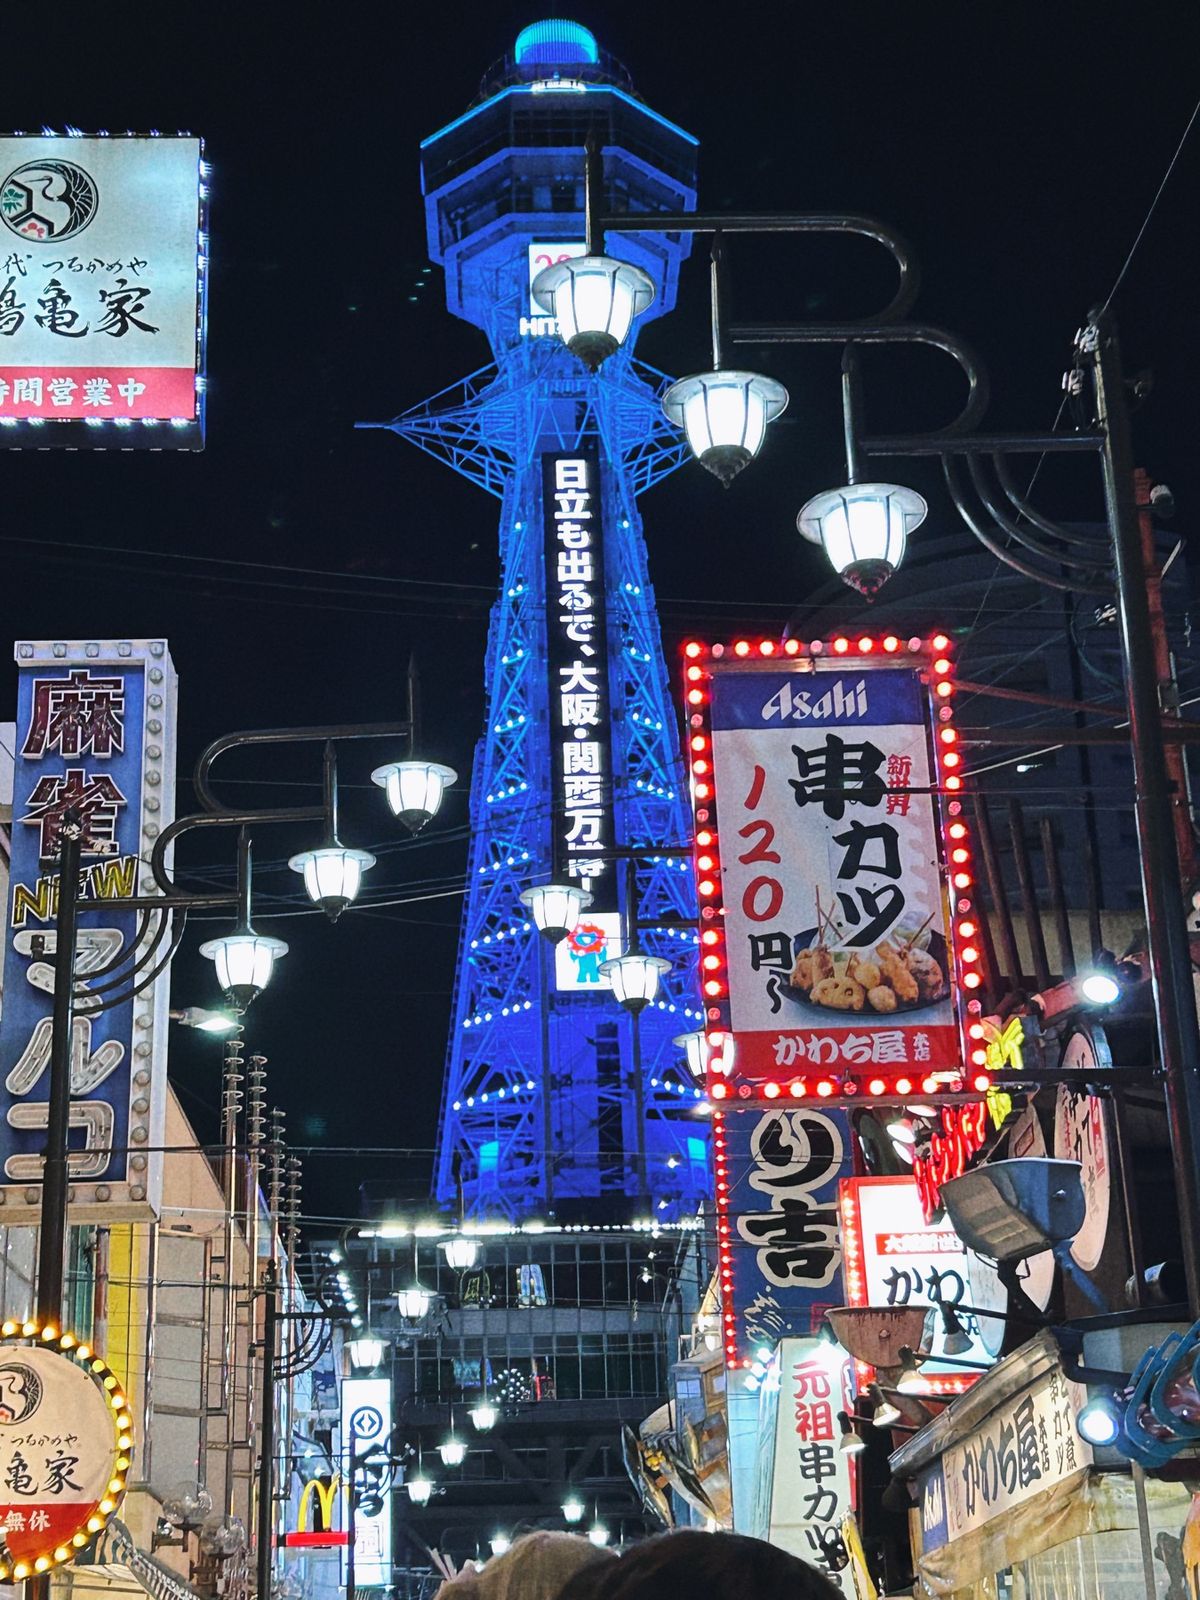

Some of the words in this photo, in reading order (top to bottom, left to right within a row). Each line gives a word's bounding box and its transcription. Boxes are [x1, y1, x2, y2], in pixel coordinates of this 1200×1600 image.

[43, 256, 148, 276] つるかめや
[761, 680, 868, 721] Asahi
[17, 670, 127, 863] 麻雀
[788, 734, 906, 947] 串カツ
[773, 1030, 908, 1066] かわち屋
[913, 1032, 931, 1061] 本店
[11, 1434, 78, 1448] つるかめや
[963, 1394, 1041, 1516] かわち屋
